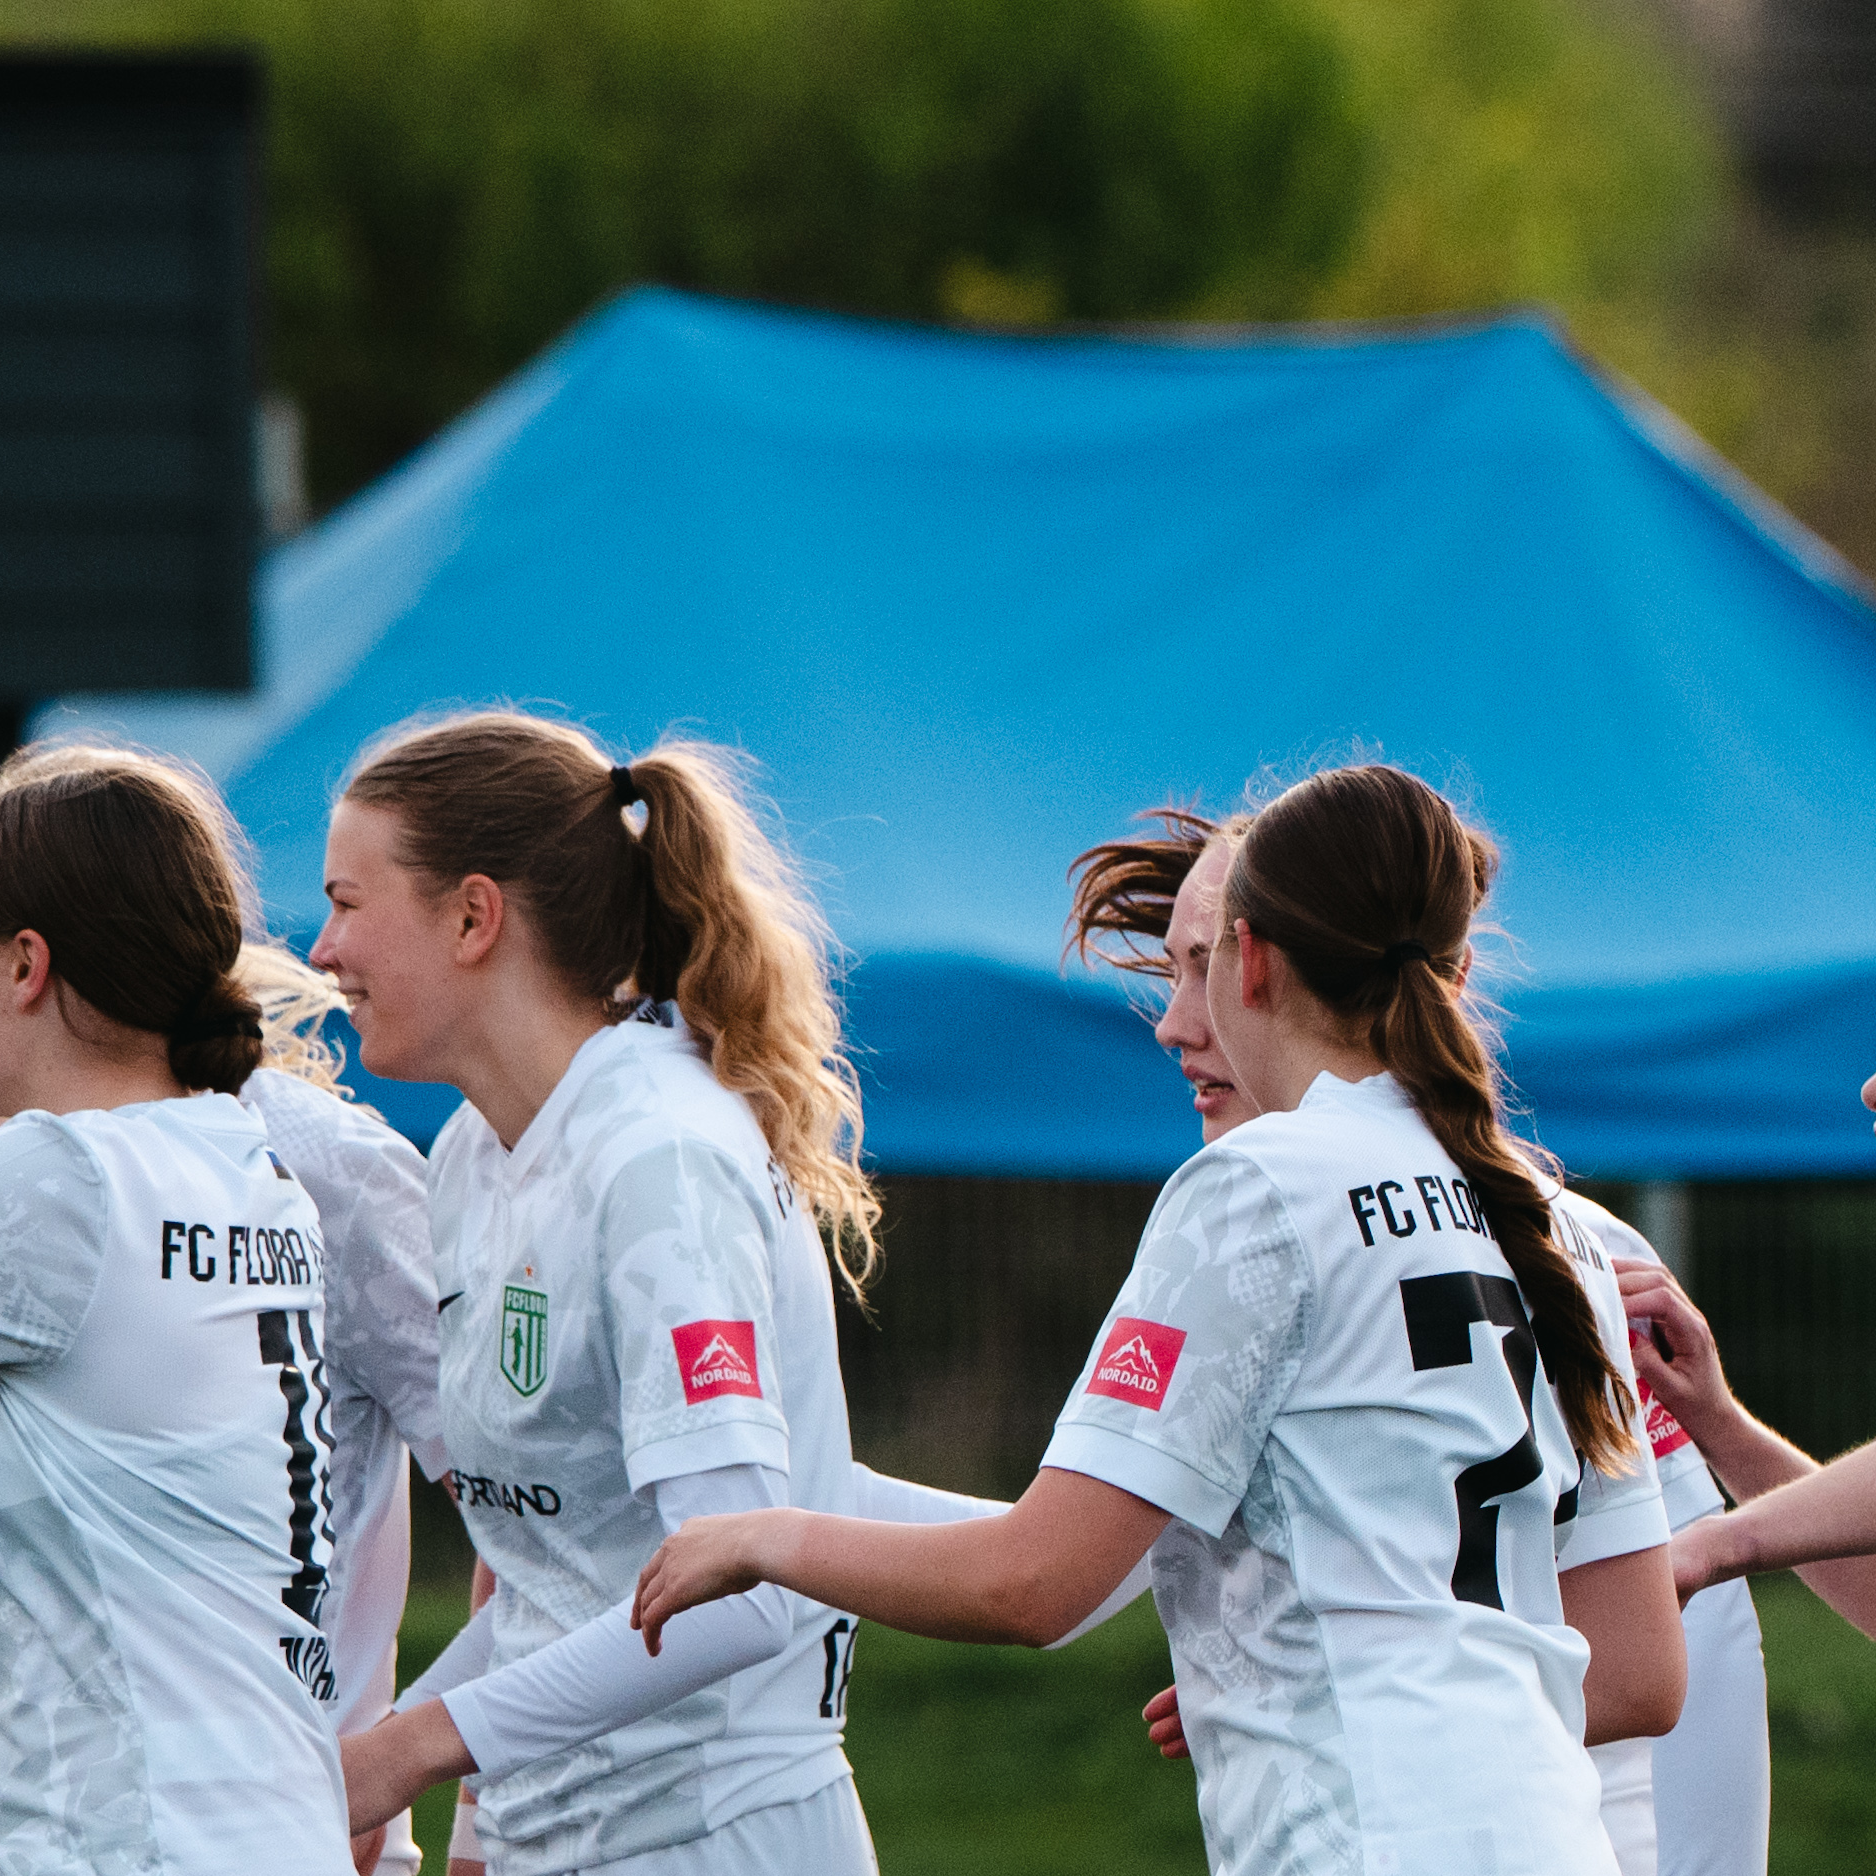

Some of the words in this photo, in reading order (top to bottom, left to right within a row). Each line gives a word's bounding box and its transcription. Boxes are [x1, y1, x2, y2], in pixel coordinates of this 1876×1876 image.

[1348, 1179, 1417, 1247] FC
[161, 1220, 215, 1282] FC
[228, 1225, 311, 1285] FLORA
[691, 1367, 752, 1389] NORDAID
[1097, 1367, 1158, 1393] NORDAID
